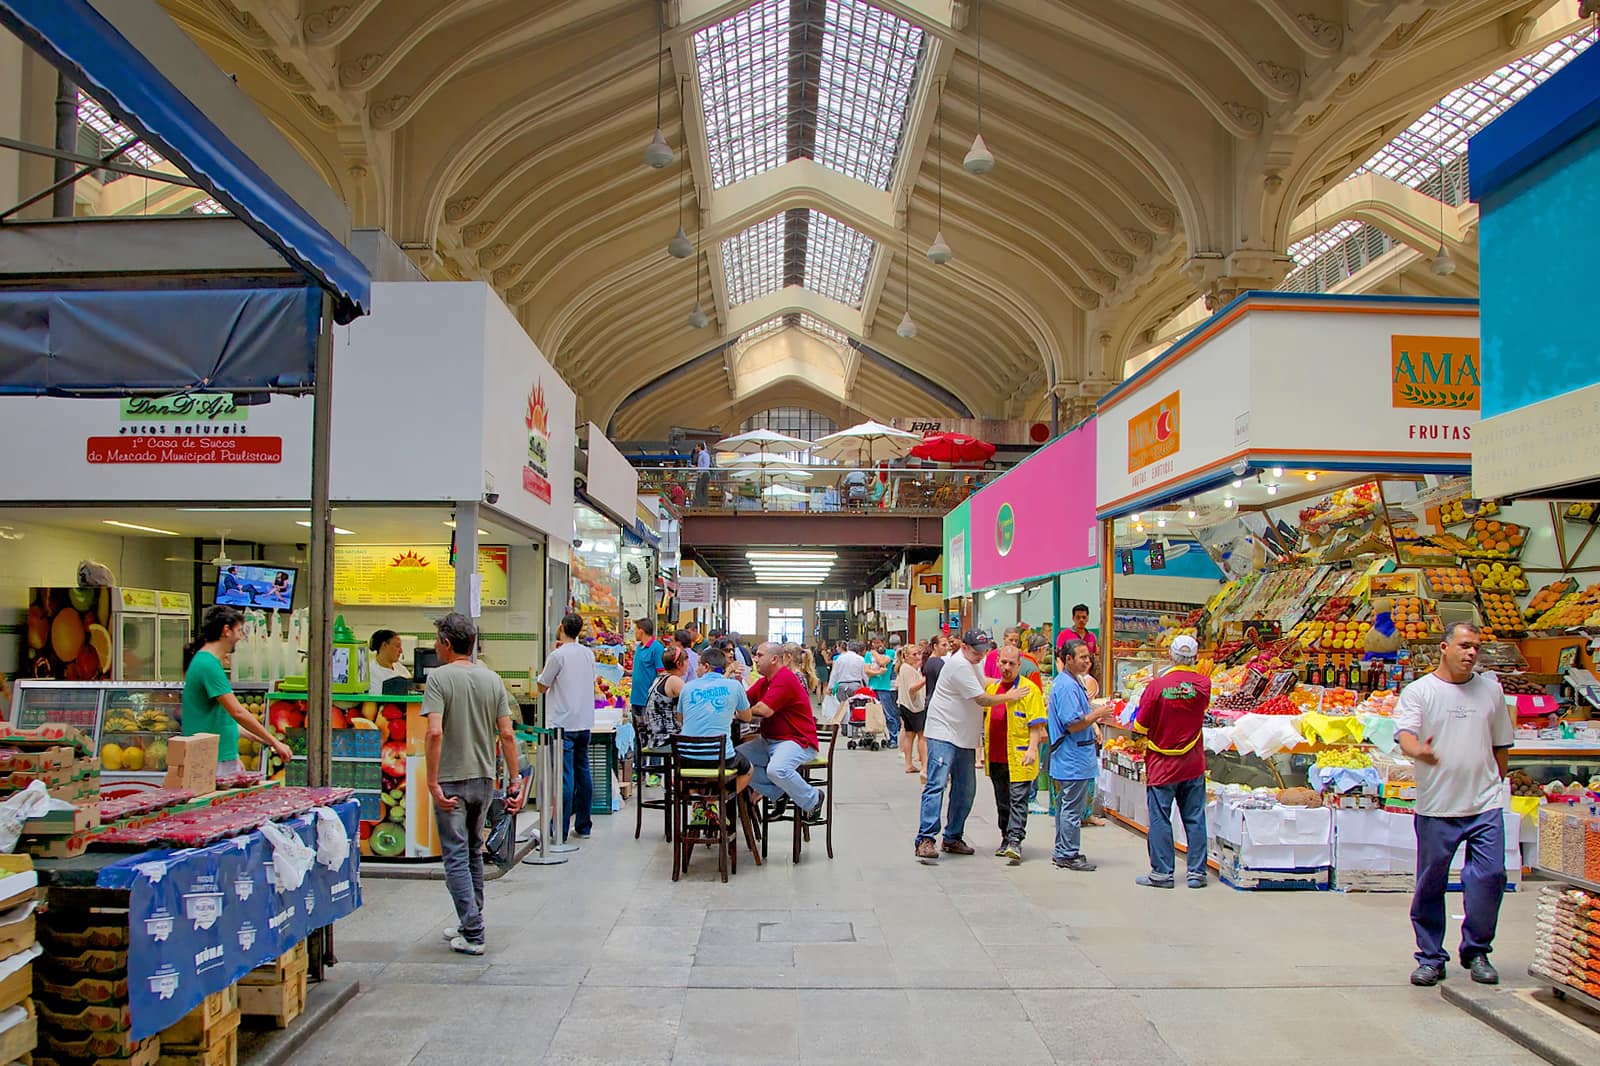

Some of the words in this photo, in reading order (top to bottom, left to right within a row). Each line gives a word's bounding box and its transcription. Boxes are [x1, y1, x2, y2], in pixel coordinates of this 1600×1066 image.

[174, 423, 247, 435] naturais
[1409, 425, 1471, 440] FRUTAS
[147, 438, 178, 448] Casa
[182, 438, 196, 448] de
[199, 438, 236, 448] Sucos
[88, 451, 103, 462] do
[107, 450, 157, 462] Mercado
[161, 450, 216, 463] Municipal
[221, 450, 280, 462] Paulistano
